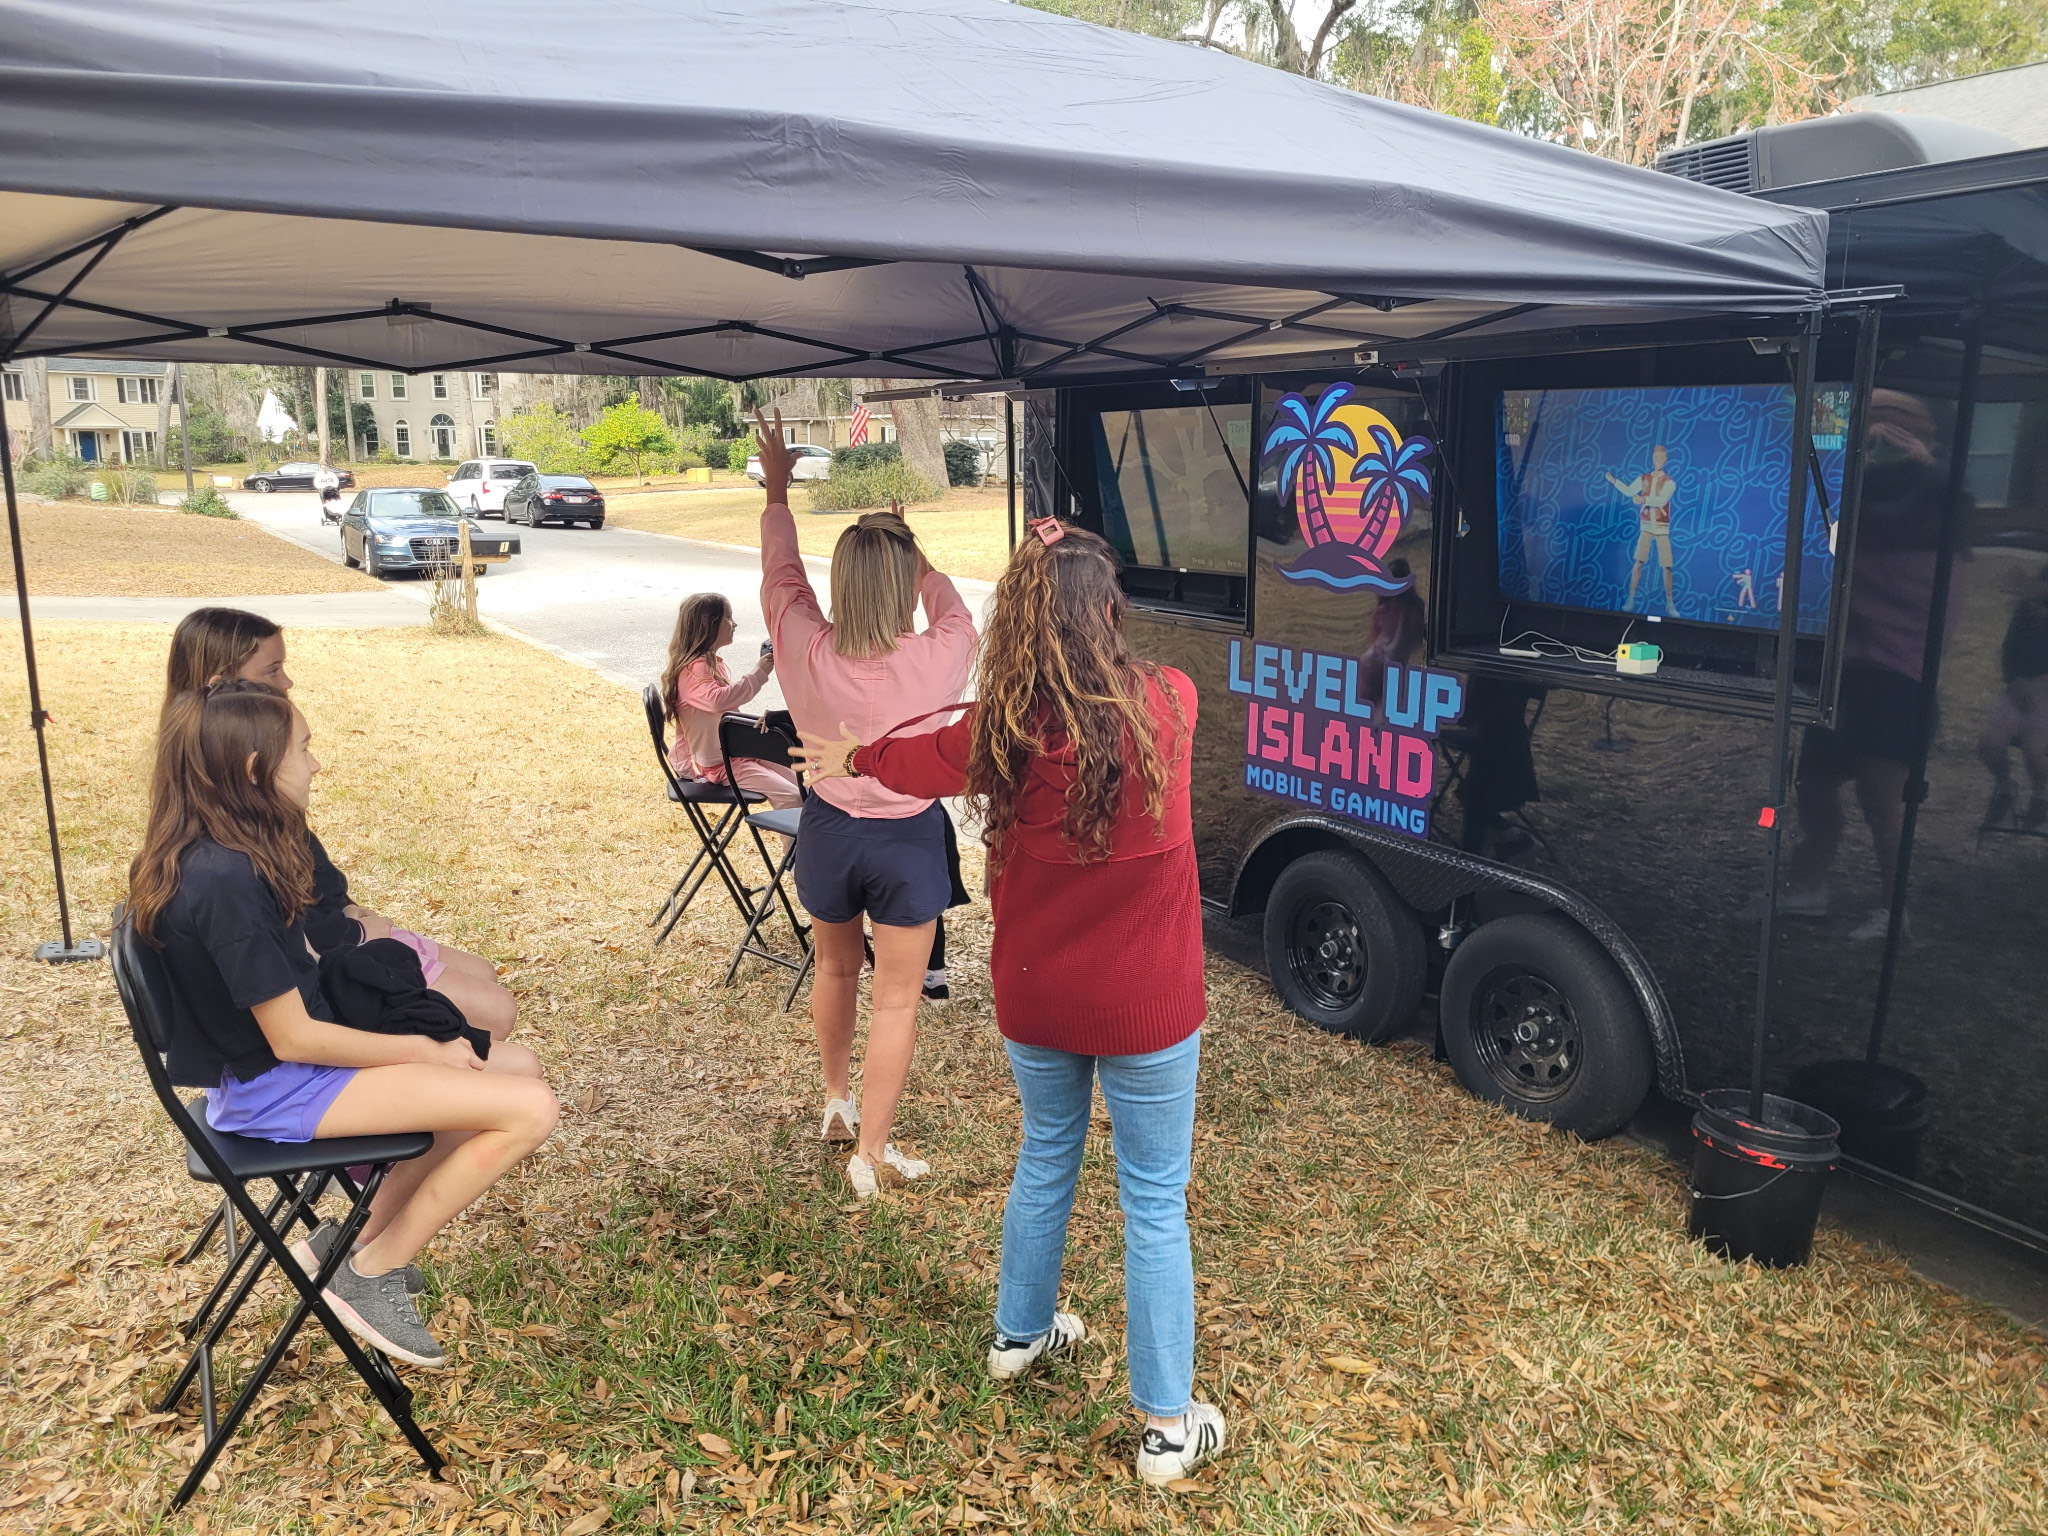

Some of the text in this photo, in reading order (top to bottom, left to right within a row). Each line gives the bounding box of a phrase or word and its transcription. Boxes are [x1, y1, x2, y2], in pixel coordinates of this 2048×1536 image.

[1838, 390, 1850, 404] 2P
[1229, 640, 1462, 733] LEVEL UP
[1247, 702, 1433, 798] ISLAND
[1246, 764, 1425, 834] MOBILE GAMING
